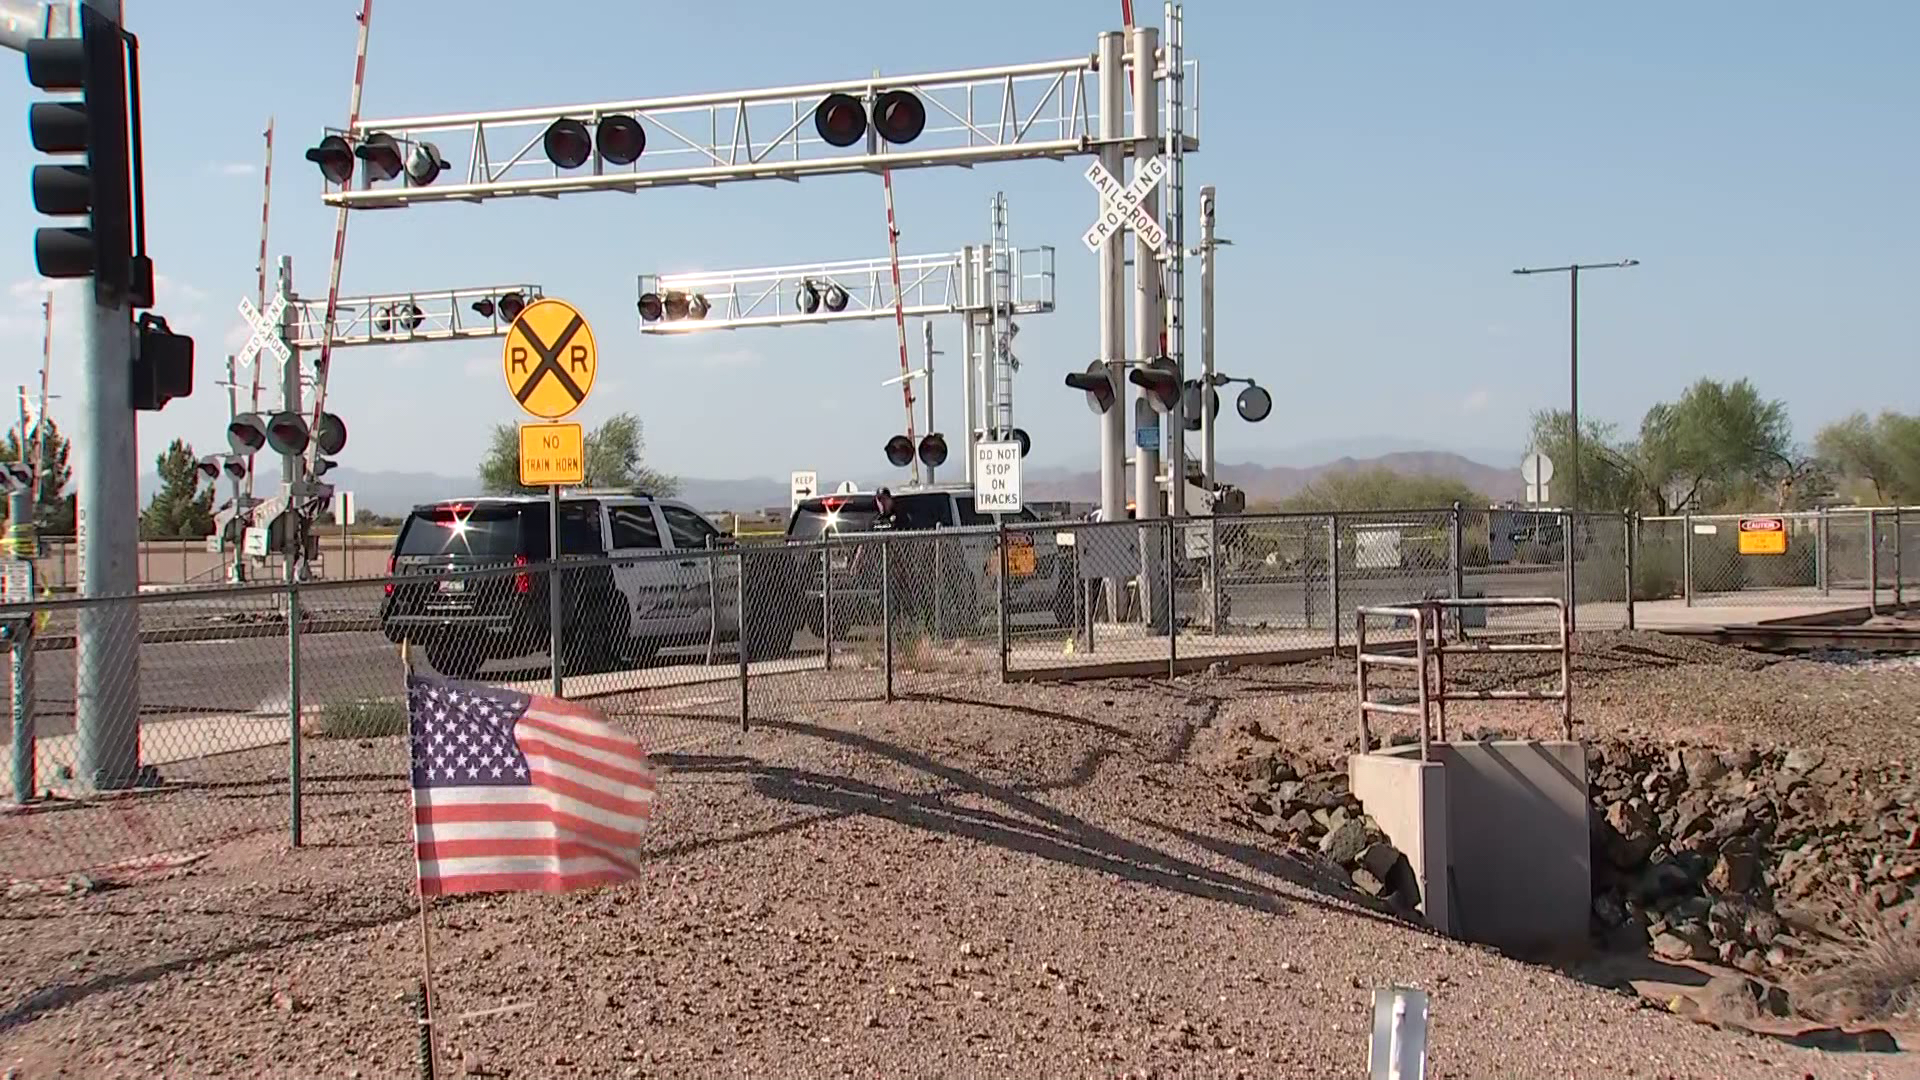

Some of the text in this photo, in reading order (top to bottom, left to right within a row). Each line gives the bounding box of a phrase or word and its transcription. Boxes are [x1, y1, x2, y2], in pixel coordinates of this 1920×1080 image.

[1087, 161, 1162, 247] CROSSING
[543, 435, 560, 449] NO
[979, 448, 1017, 460] DO NOT
[526, 457, 579, 472] TRAIN HORN
[986, 463, 1011, 475] STOP
[795, 476, 814, 484] KEEP
[991, 478, 1005, 490] ON
[979, 493, 1018, 504] TRACKS
